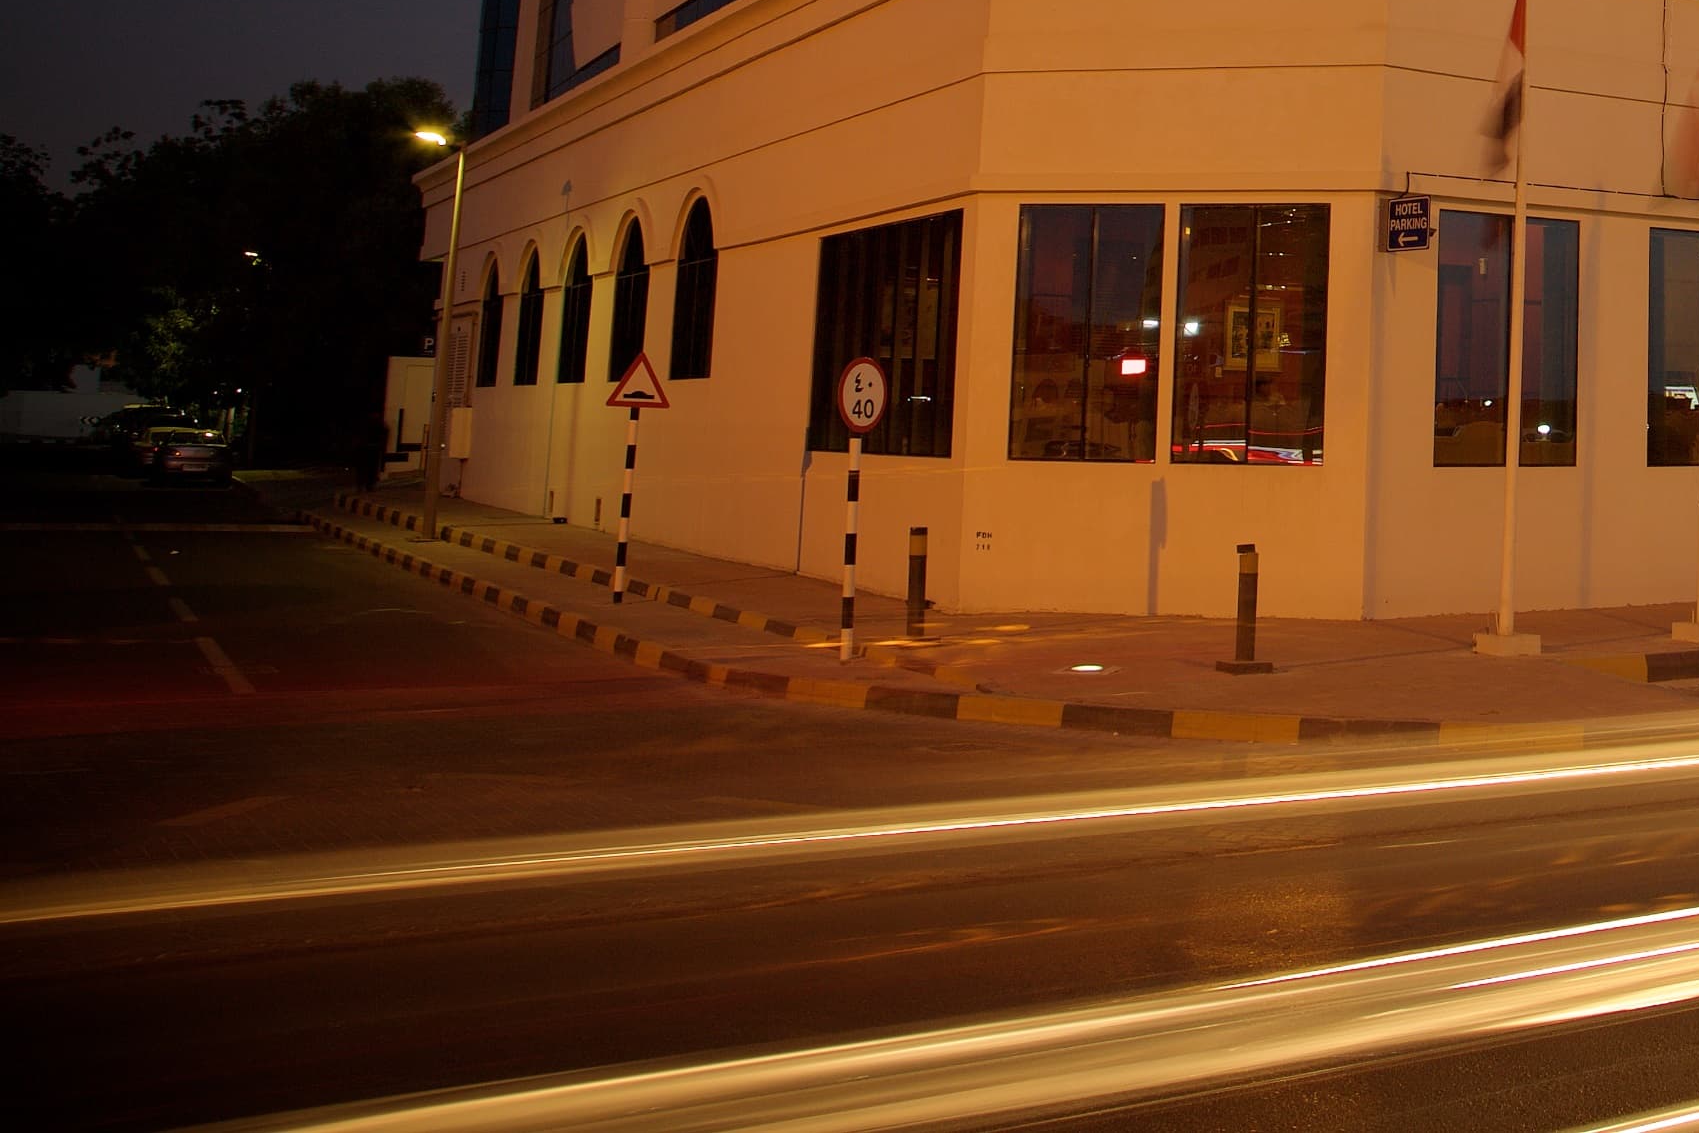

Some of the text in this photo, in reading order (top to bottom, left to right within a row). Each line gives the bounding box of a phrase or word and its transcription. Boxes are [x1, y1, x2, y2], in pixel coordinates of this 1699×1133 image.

[1395, 202, 1423, 216] HOTEL
[1390, 217, 1428, 231] PARKING
[423, 337, 435, 350] P
[852, 399, 874, 419] 40
